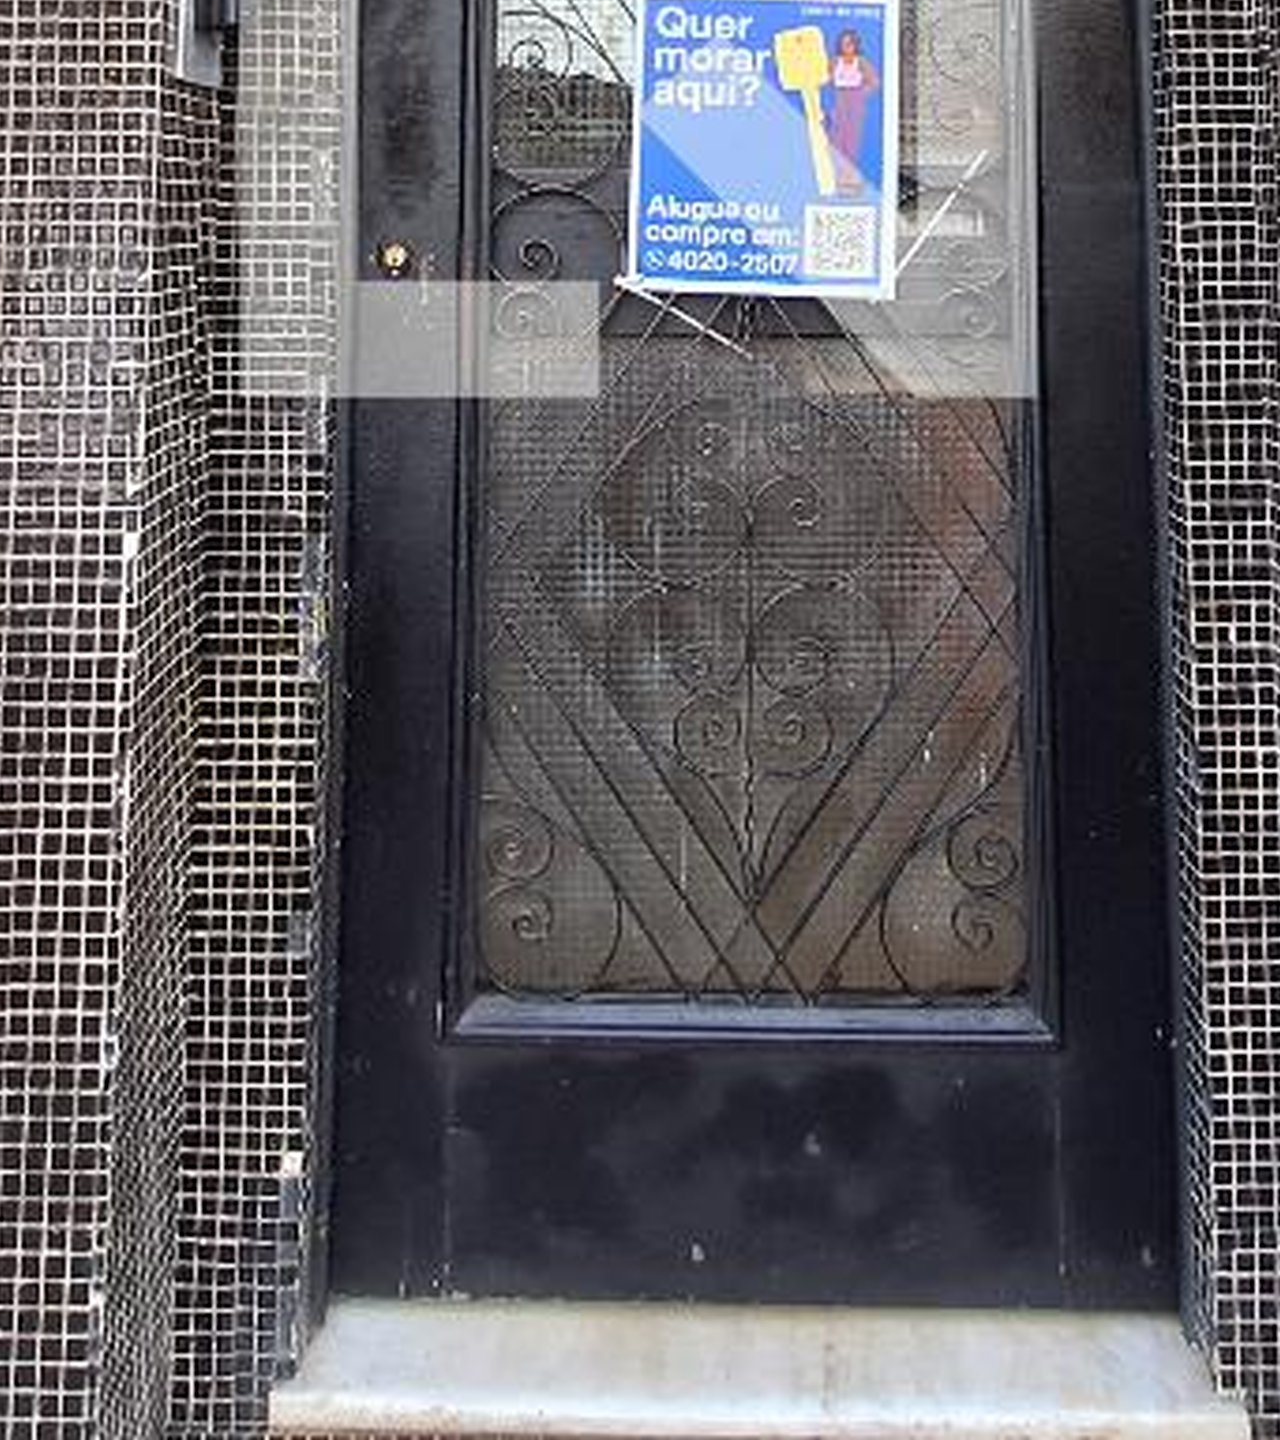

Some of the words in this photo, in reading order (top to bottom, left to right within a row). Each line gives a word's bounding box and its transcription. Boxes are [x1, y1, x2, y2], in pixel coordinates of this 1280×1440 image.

[655, 6, 754, 41] Quer
[654, 44, 771, 74] morar
[653, 76, 760, 113] aqui?
[646, 193, 741, 223] Alugue
[744, 201, 781, 223] ou
